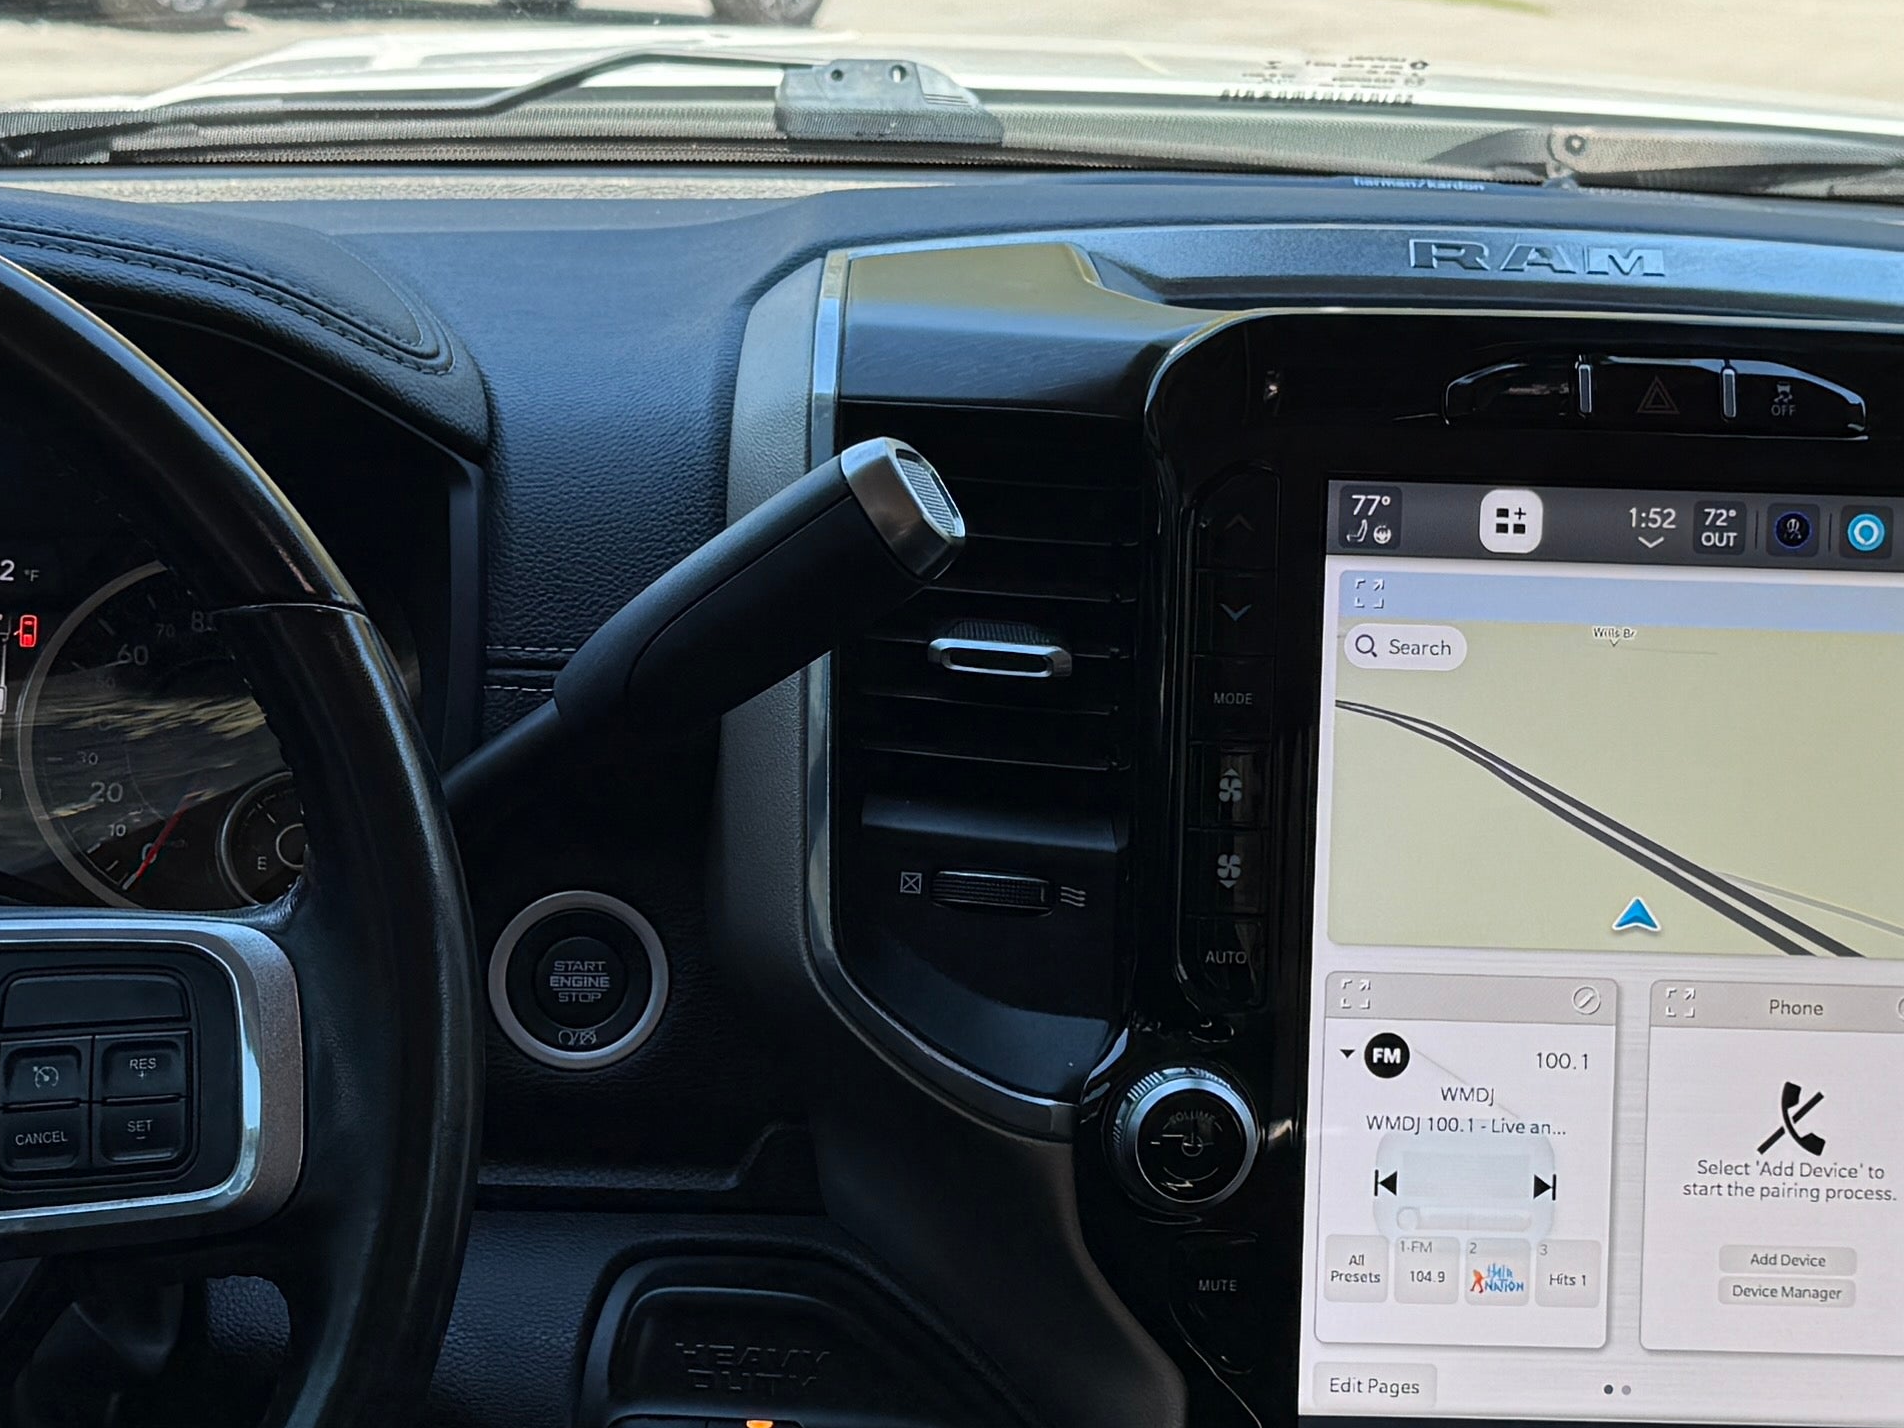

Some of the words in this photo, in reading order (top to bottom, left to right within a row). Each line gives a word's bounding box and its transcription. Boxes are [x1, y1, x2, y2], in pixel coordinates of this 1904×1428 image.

[1408, 237, 1666, 278] RAM
[1770, 403, 1797, 418] OFF
[1628, 507, 1677, 531] 1:52
[1700, 530, 1739, 548] OUT
[116, 643, 150, 667] 60
[1387, 638, 1452, 657] Search
[1212, 692, 1254, 706] MODE
[90, 781, 124, 804] 20
[109, 822, 127, 838] 10
[257, 856, 268, 872] E
[1205, 950, 1248, 965] AUTO
[553, 960, 607, 972] START
[549, 975, 611, 988] ENGINE
[557, 992, 603, 1003] STOP
[1768, 997, 1824, 1018] Phone
[128, 1057, 158, 1071] RES
[1372, 1047, 1402, 1065] FM
[1535, 1052, 1589, 1071] 100.1
[1440, 1086, 1495, 1107] WMDJ
[126, 1119, 154, 1133] SET
[1366, 1114, 1422, 1135] WMDJ
[1428, 1115, 1475, 1133] 100.1
[1491, 1117, 1526, 1135] Live
[14, 1130, 70, 1147] CANCEL
[1696, 1159, 1752, 1177] Select
[1756, 1160, 1794, 1177] 'Add
[1799, 1162, 1864, 1179] Device'
[1868, 1165, 1885, 1180] to
[1682, 1182, 1723, 1196] start
[1727, 1181, 1755, 1197] the
[1759, 1182, 1820, 1203] pairing
[1825, 1185, 1898, 1203] process.
[1469, 1242, 1477, 1255] 2
[1539, 1243, 1549, 1256] 3
[1348, 1253, 1365, 1267] All
[1749, 1253, 1778, 1267] Add
[1780, 1254, 1827, 1268] Device
[1330, 1270, 1381, 1283] Presets
[1409, 1271, 1446, 1283] 104.9
[1548, 1274, 1576, 1287] Hits
[1197, 1278, 1238, 1293] MUTE
[1732, 1284, 1779, 1298] Device
[1781, 1286, 1843, 1302] Manager
[1328, 1376, 1363, 1396] Edit
[1367, 1377, 1420, 1399] Pages
